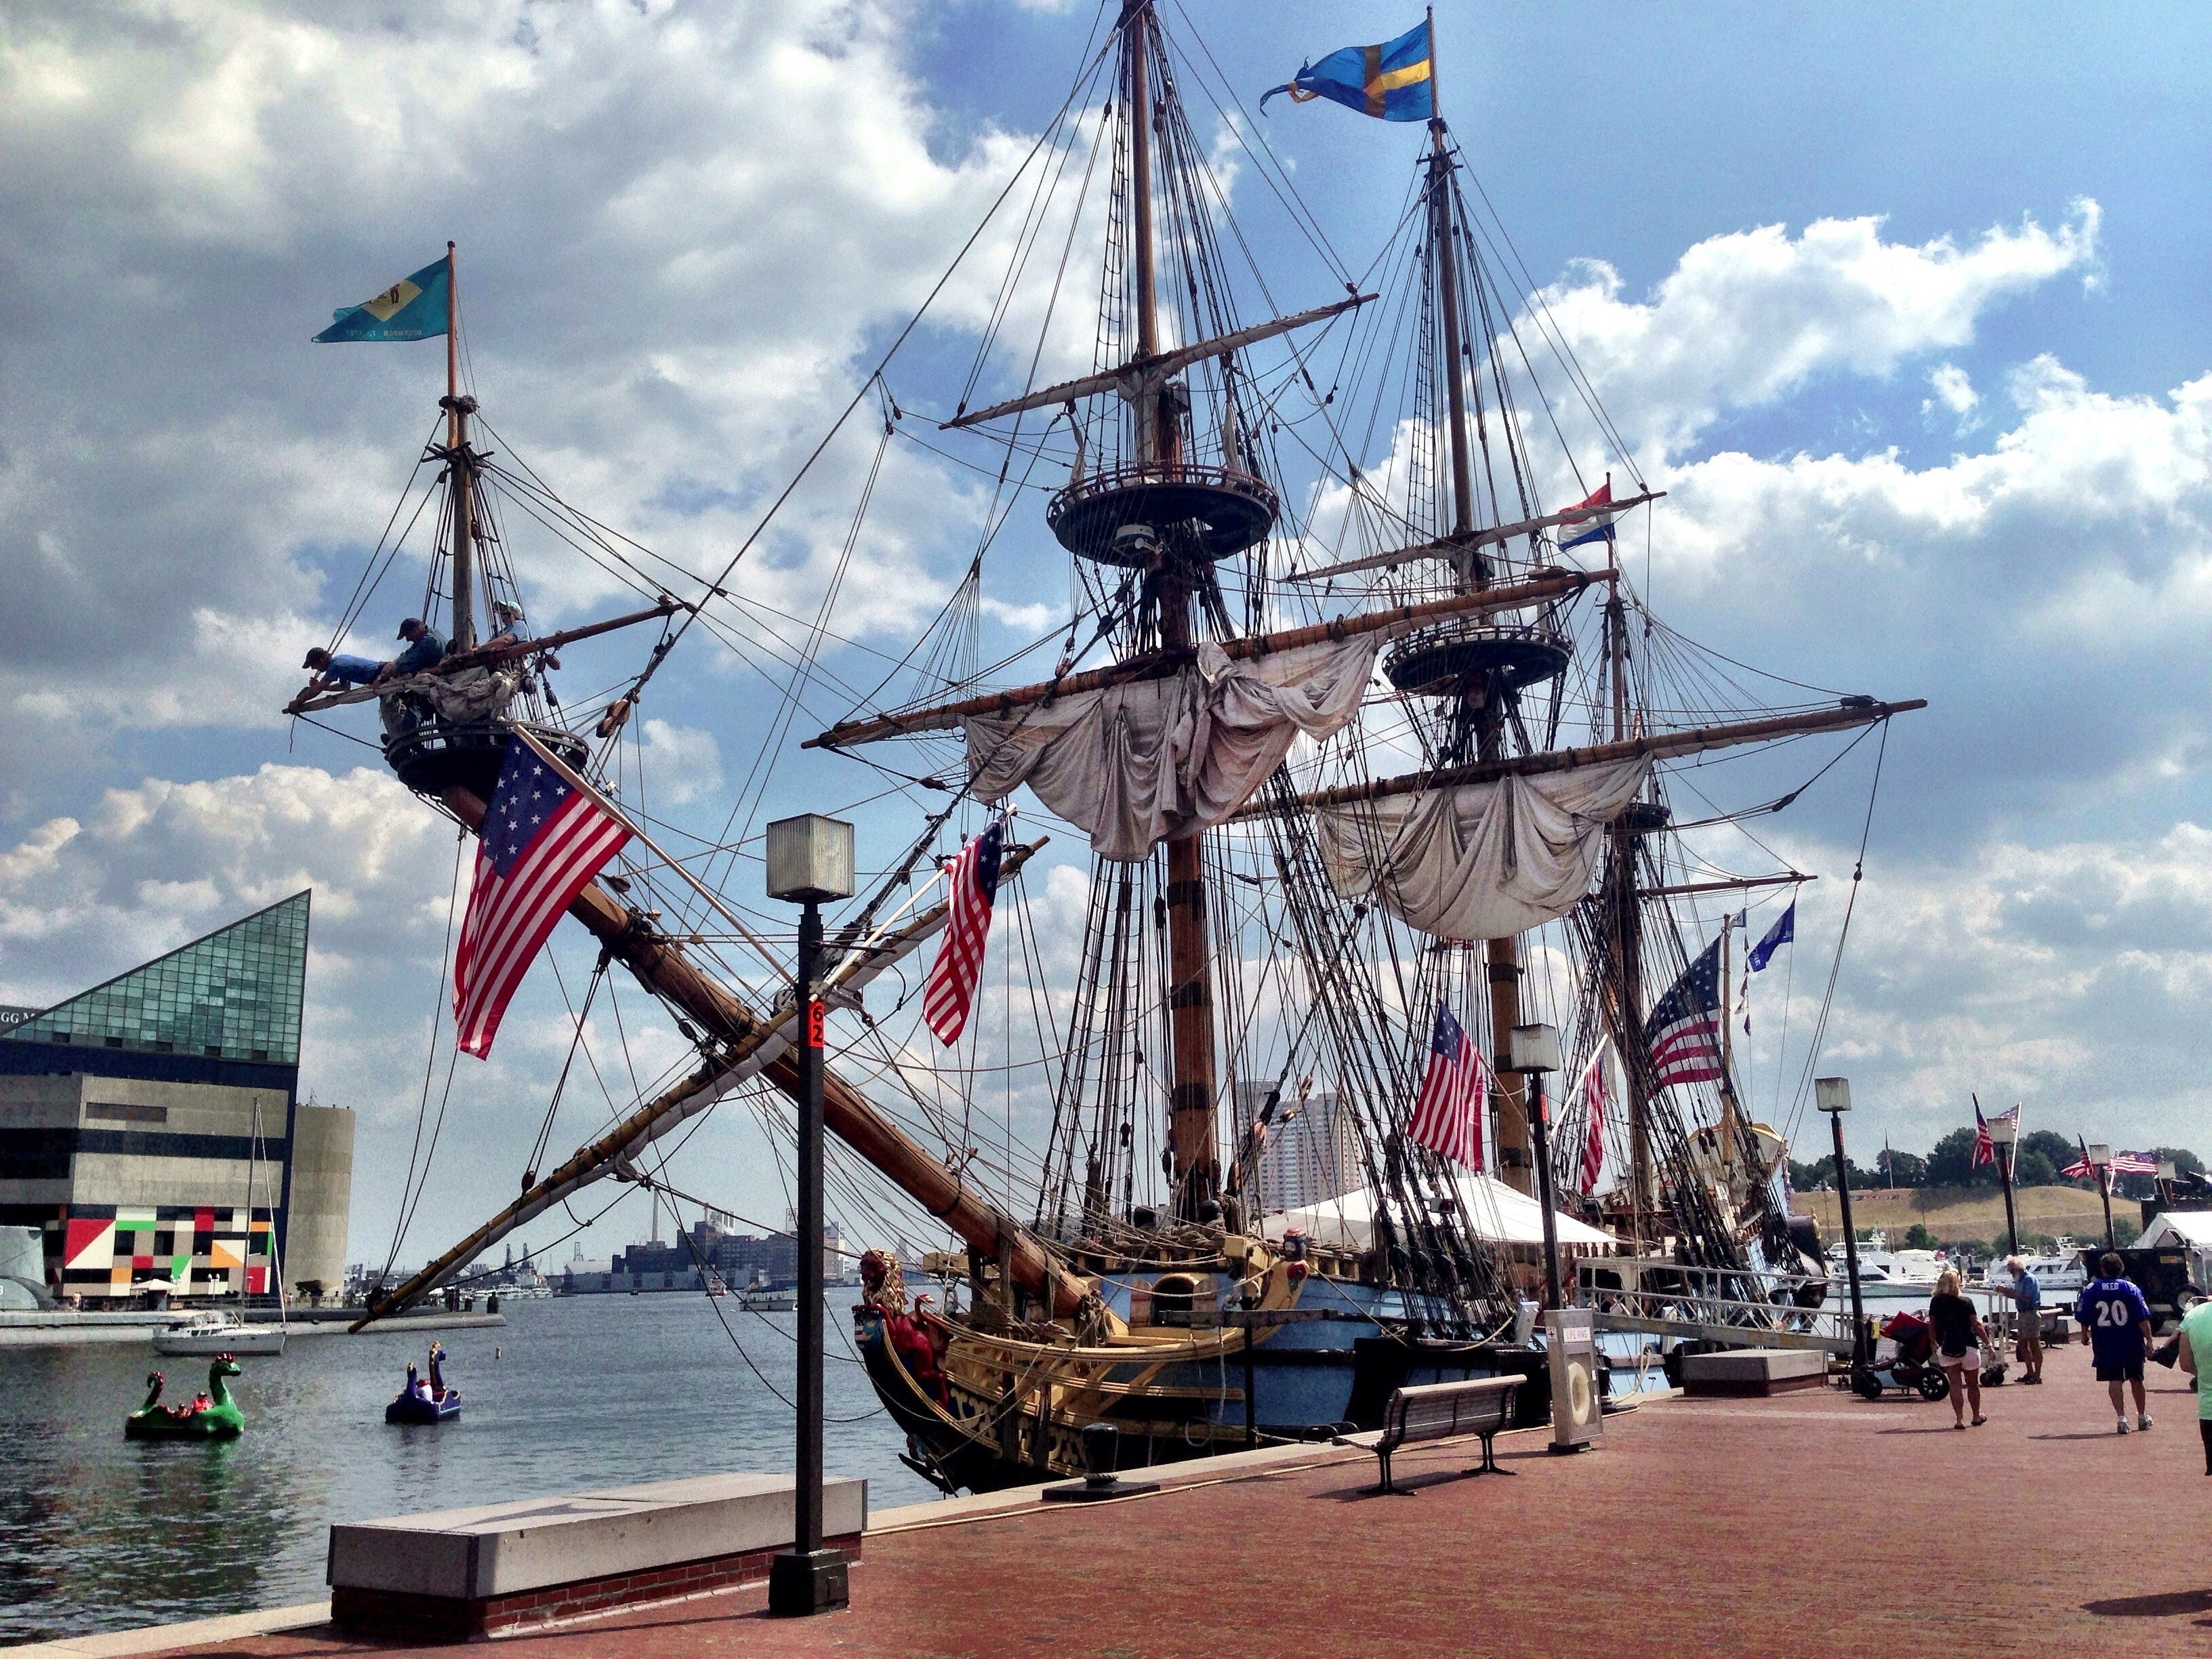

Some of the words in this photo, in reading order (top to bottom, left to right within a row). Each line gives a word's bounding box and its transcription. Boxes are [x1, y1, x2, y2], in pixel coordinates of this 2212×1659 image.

[813, 1005, 823, 1043] 62
[2102, 1282, 2118, 1290] REED
[2095, 1300, 2128, 1327] 20
